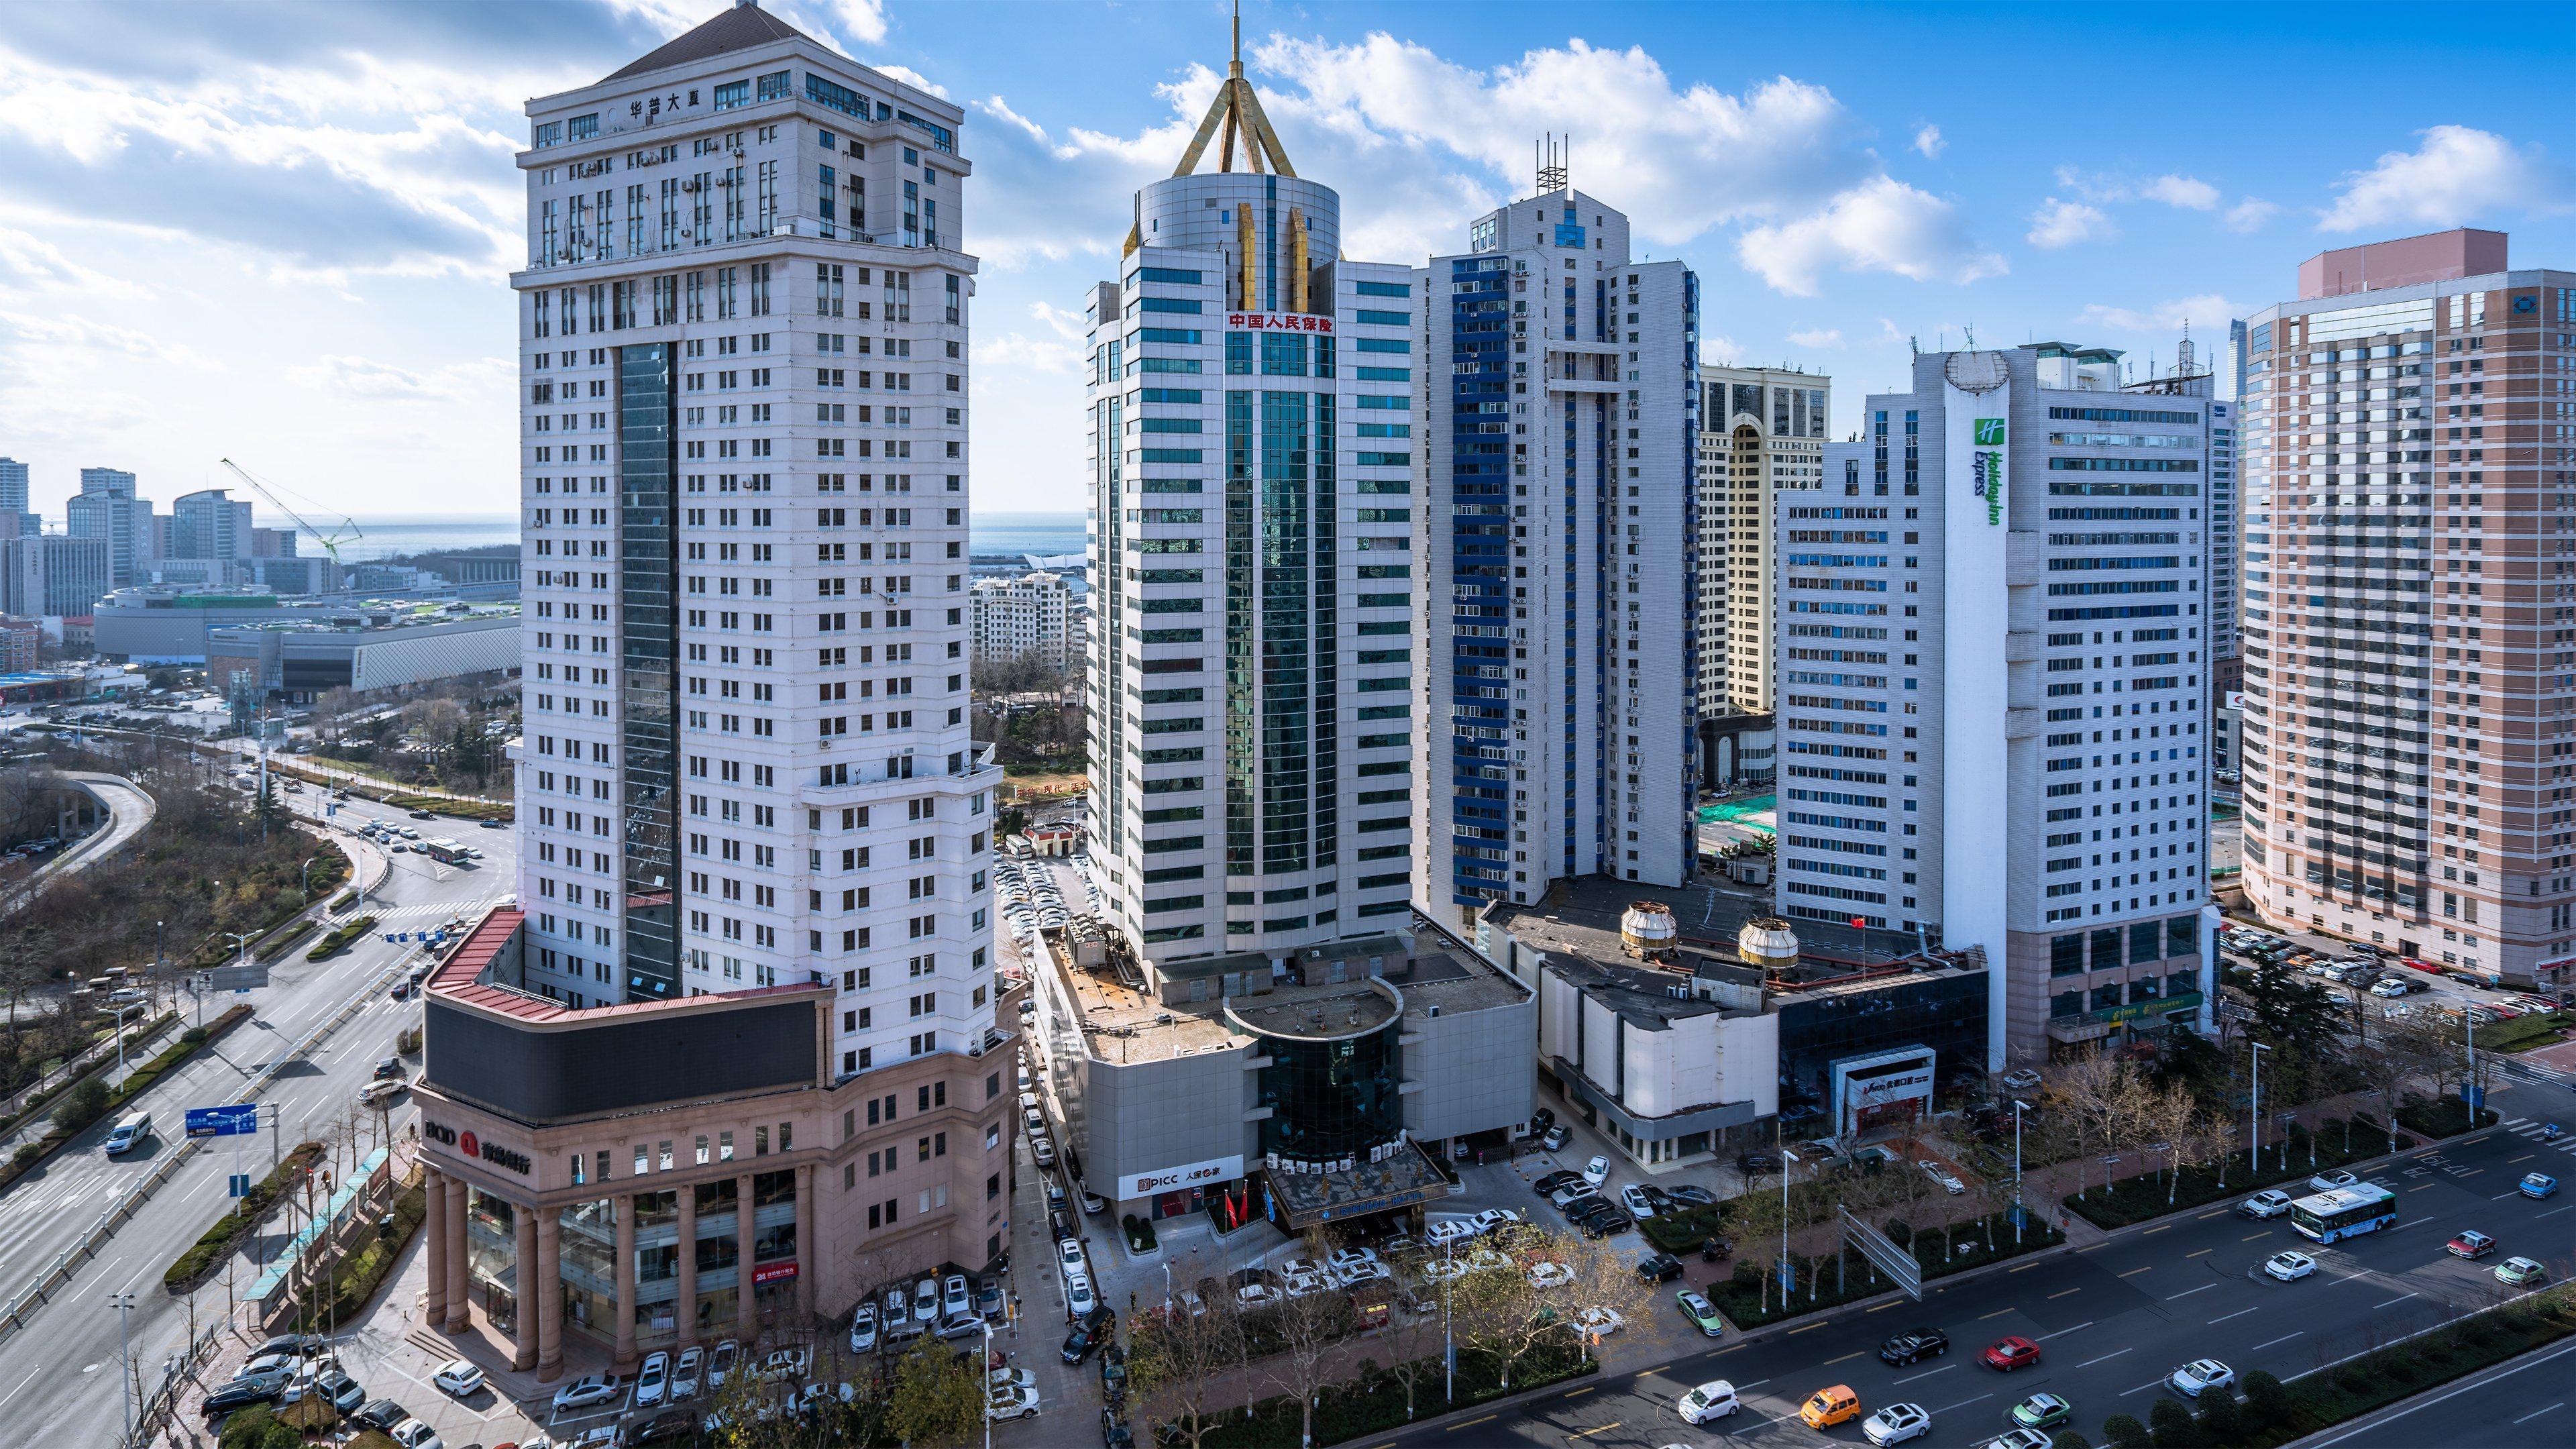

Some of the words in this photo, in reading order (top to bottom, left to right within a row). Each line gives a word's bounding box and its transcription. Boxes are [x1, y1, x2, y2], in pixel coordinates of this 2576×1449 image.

[1229, 313, 1333, 333] 中国人民保险
[1972, 451, 1988, 496] Express
[1985, 451, 2003, 502] Holiday
[1988, 504, 2004, 526] Inn
[1043, 783, 1063, 795] 现代
[1151, 1175, 1178, 1188] PICC
[1340, 1199, 1387, 1216] QINGDAO
[1391, 1192, 1425, 1205] HOTEL
